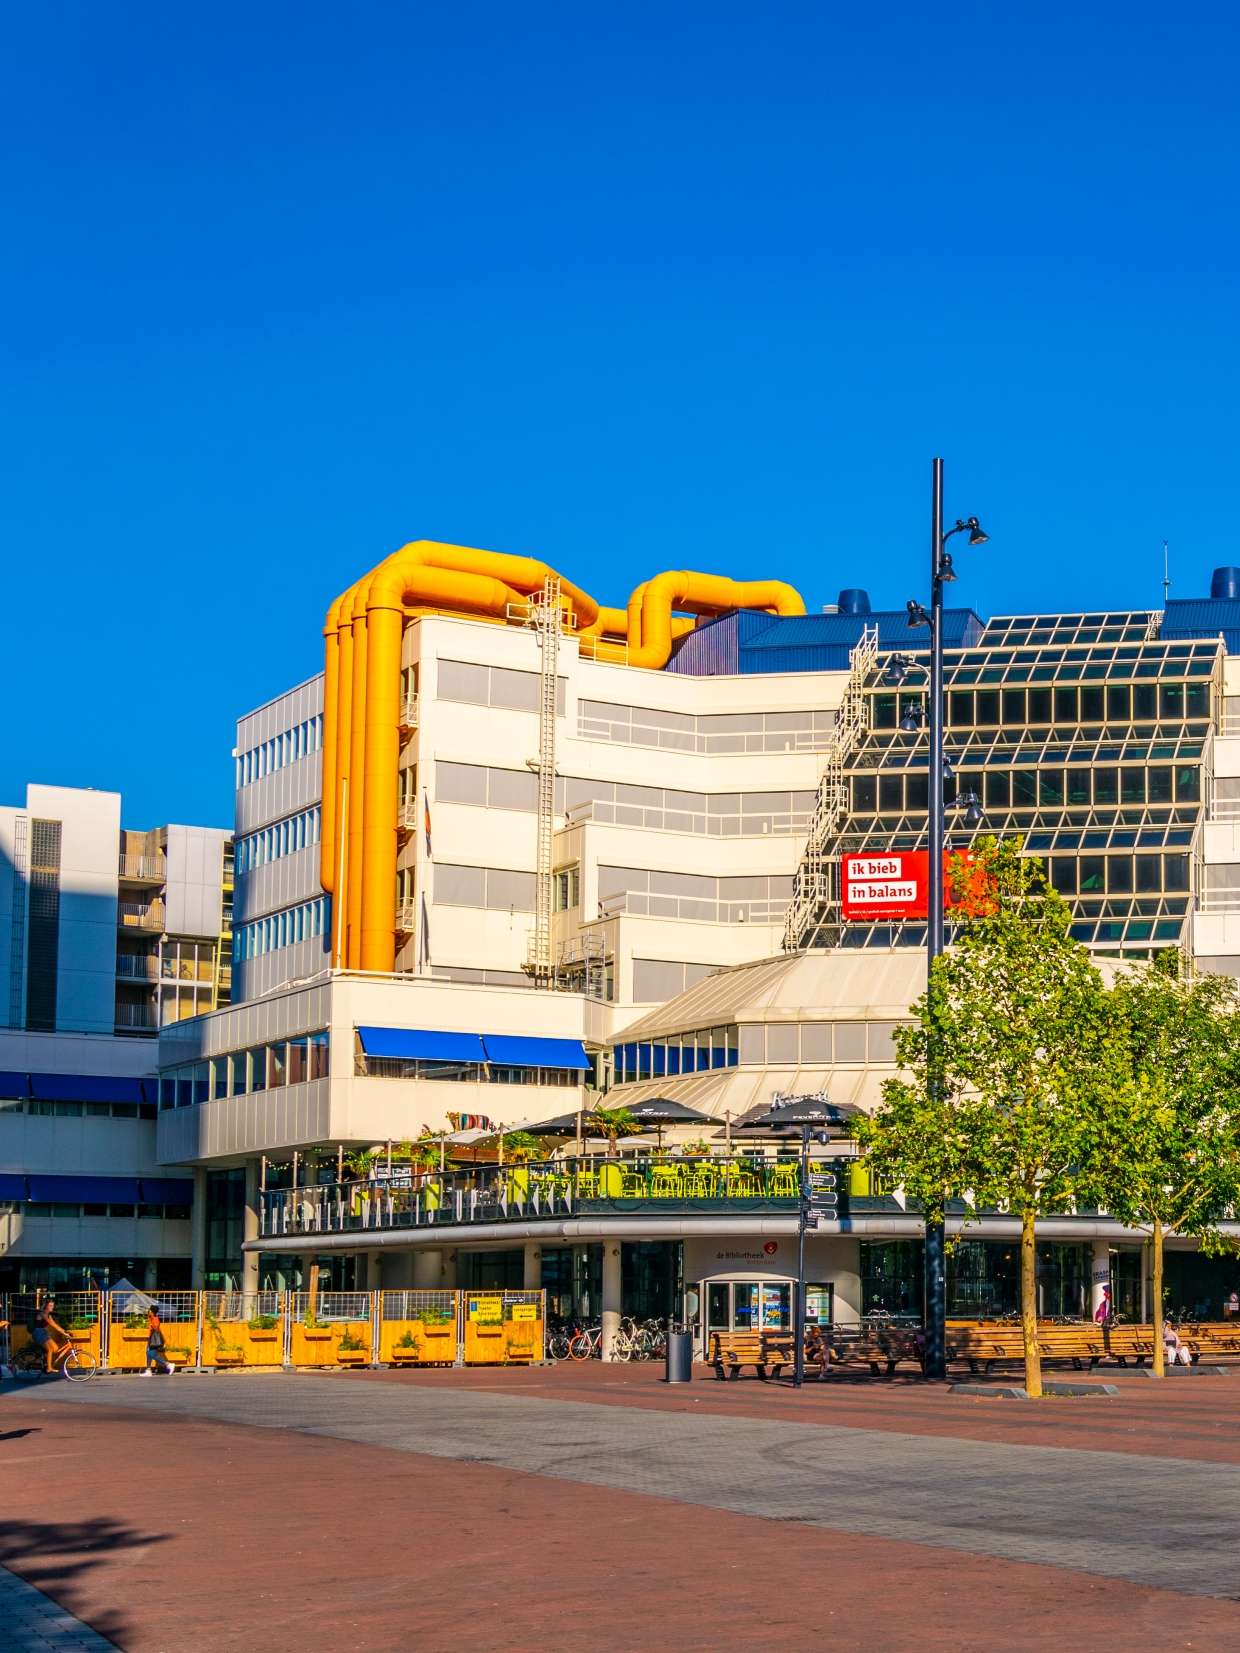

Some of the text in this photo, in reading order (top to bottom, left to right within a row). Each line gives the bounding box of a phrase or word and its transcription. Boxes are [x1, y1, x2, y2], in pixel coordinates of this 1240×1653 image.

[852, 862, 898, 875] ik bieb
[852, 885, 913, 899] in balans
[261, 1188, 477, 1235] THE ONLY WAY IS UP
[725, 1251, 765, 1259] Bibliotheek
